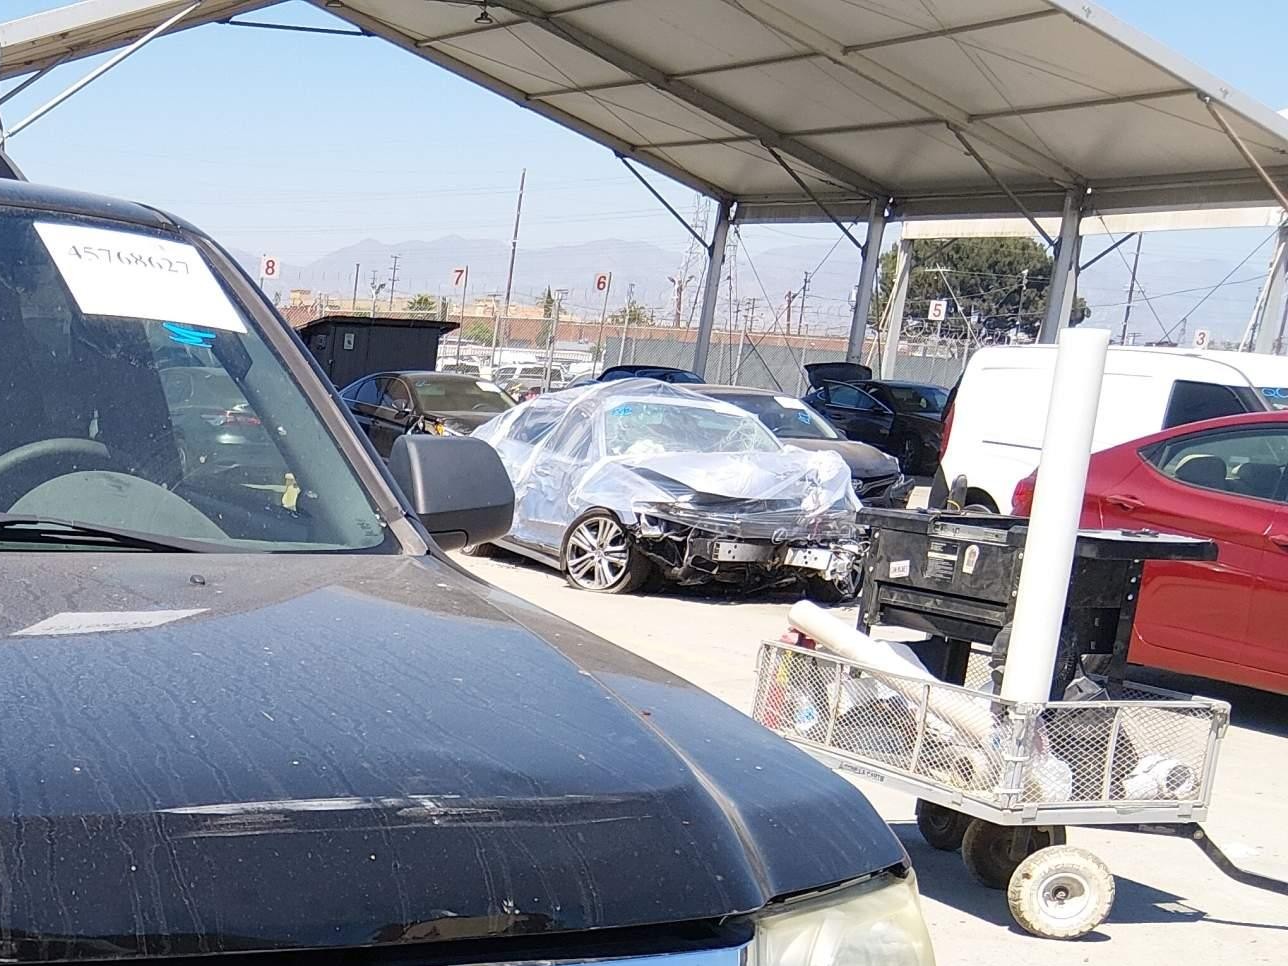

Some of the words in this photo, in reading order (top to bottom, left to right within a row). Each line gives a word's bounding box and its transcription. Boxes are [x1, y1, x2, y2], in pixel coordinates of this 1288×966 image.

[68, 245, 190, 275] 45768627
[265, 259, 276, 276] 8
[454, 269, 465, 286] 7
[596, 275, 607, 291] 6
[932, 303, 943, 318] 5
[1196, 331, 1206, 346] 3
